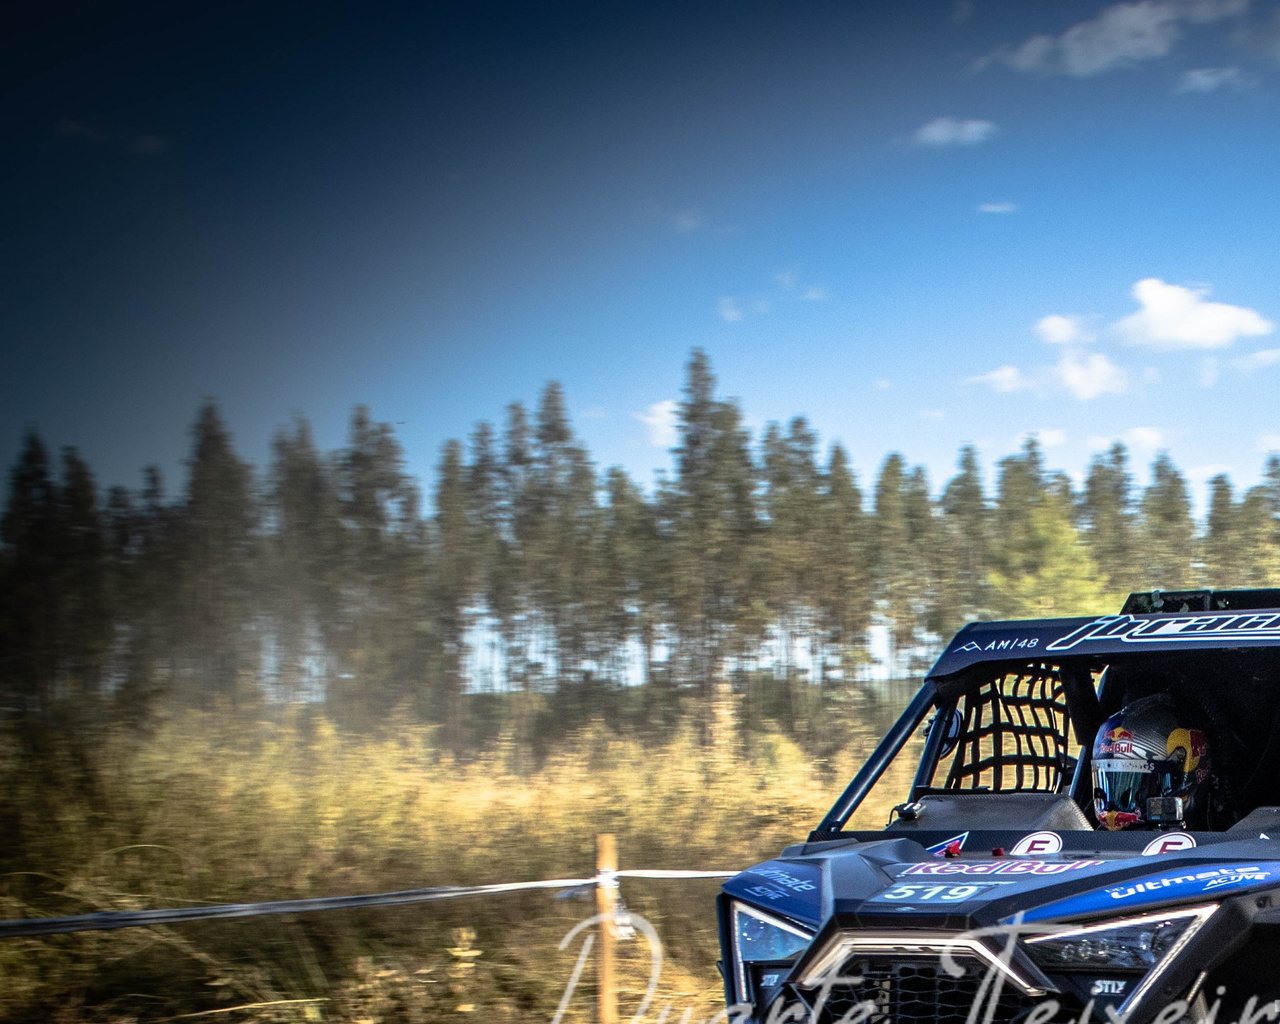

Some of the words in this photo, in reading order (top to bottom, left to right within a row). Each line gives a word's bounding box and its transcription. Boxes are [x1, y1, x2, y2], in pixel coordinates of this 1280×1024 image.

[1100, 742, 1115, 753] Red
[1115, 742, 1133, 753] Bull
[901, 861, 1012, 875] Red
[1205, 873, 1268, 887] ACTIVE
[883, 885, 979, 901] 519
